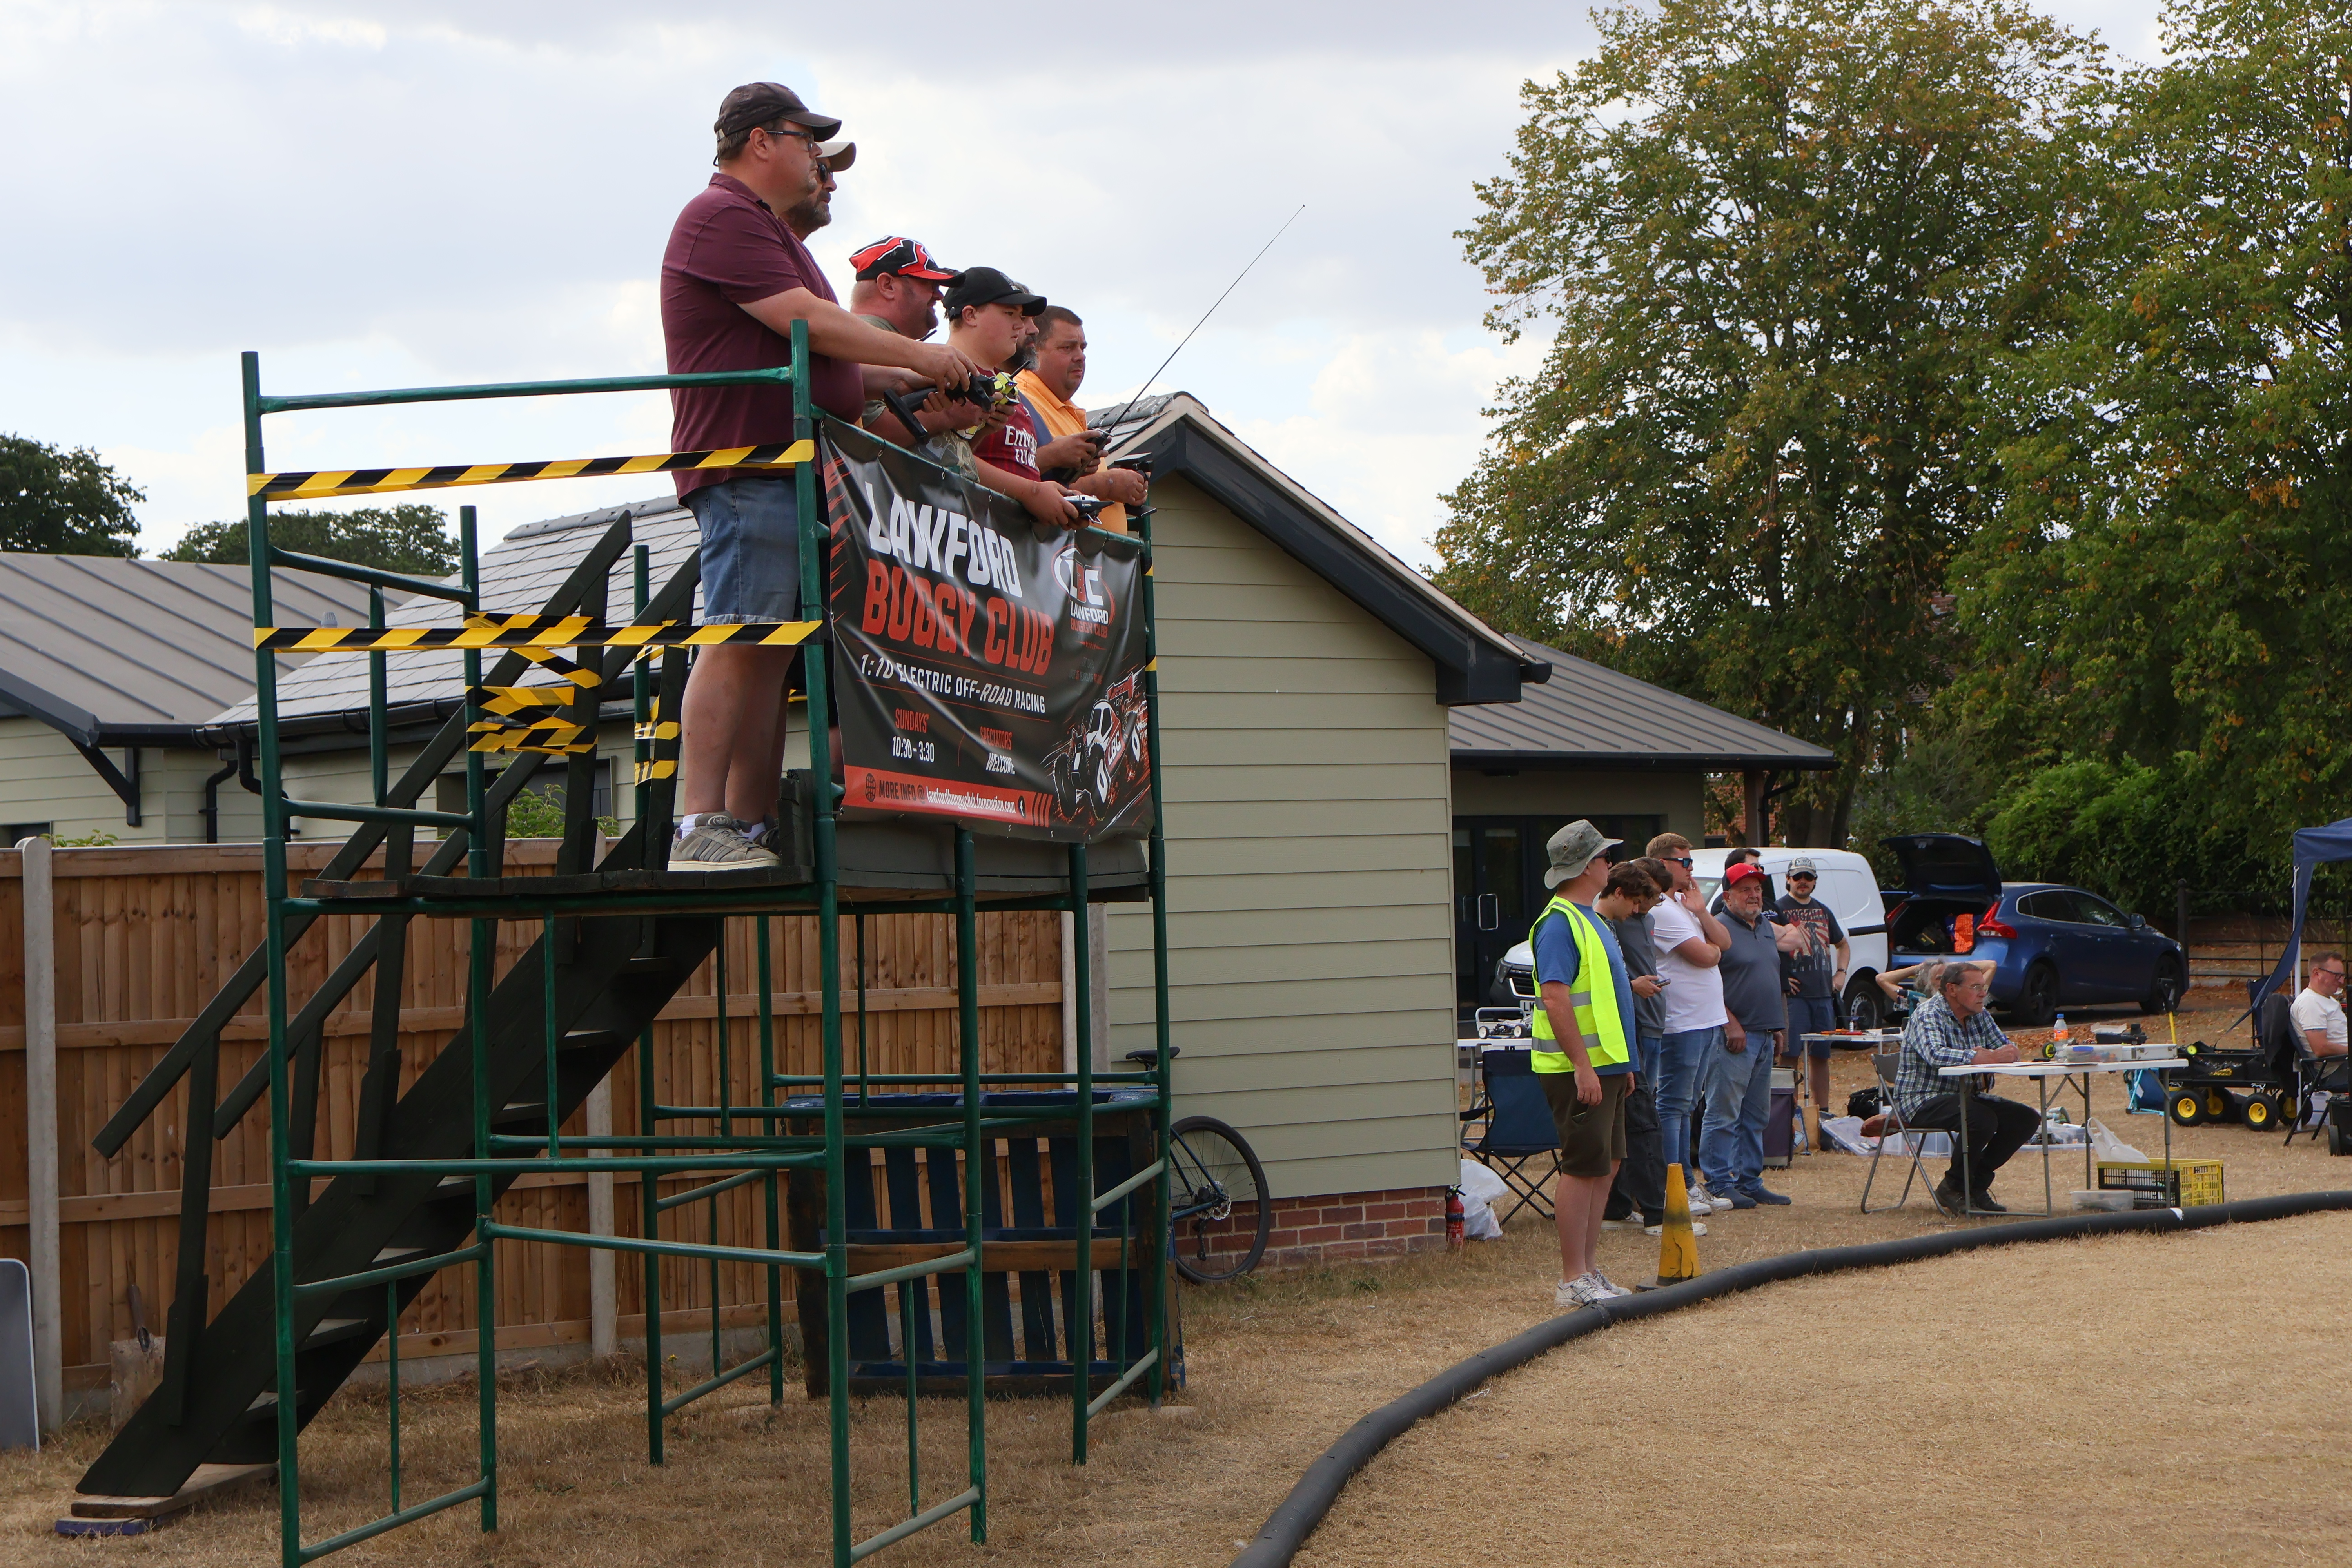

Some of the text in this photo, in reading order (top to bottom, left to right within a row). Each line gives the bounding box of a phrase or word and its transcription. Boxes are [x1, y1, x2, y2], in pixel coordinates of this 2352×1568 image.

[1005, 425, 1037, 454] Emirate
[1015, 448, 1028, 465] FLY
[865, 481, 1022, 598] LAWFORD
[862, 558, 1054, 674] BUGGY CLUB
[1070, 601, 1109, 625] LAWFORD
[1071, 621, 1108, 638] BUGGY CLUB
[896, 662, 951, 694] ELECTRIC
[956, 677, 1012, 706] OFF-ROAD
[1014, 690, 1045, 713] RACING
[895, 708, 929, 733] SUNDAYS
[893, 736, 912, 758] 10:30
[918, 741, 935, 762] 3:30
[980, 726, 1012, 750] SPECTATORS
[1107, 731, 1122, 766] LBC
[986, 752, 1015, 774] WELCOME
[879, 780, 898, 799] MORE
[900, 782, 916, 802] INFO
[926, 786, 1016, 813] lawfordbuggyclub.forumotion.com
[1524, 1002, 1535, 1011] LM
